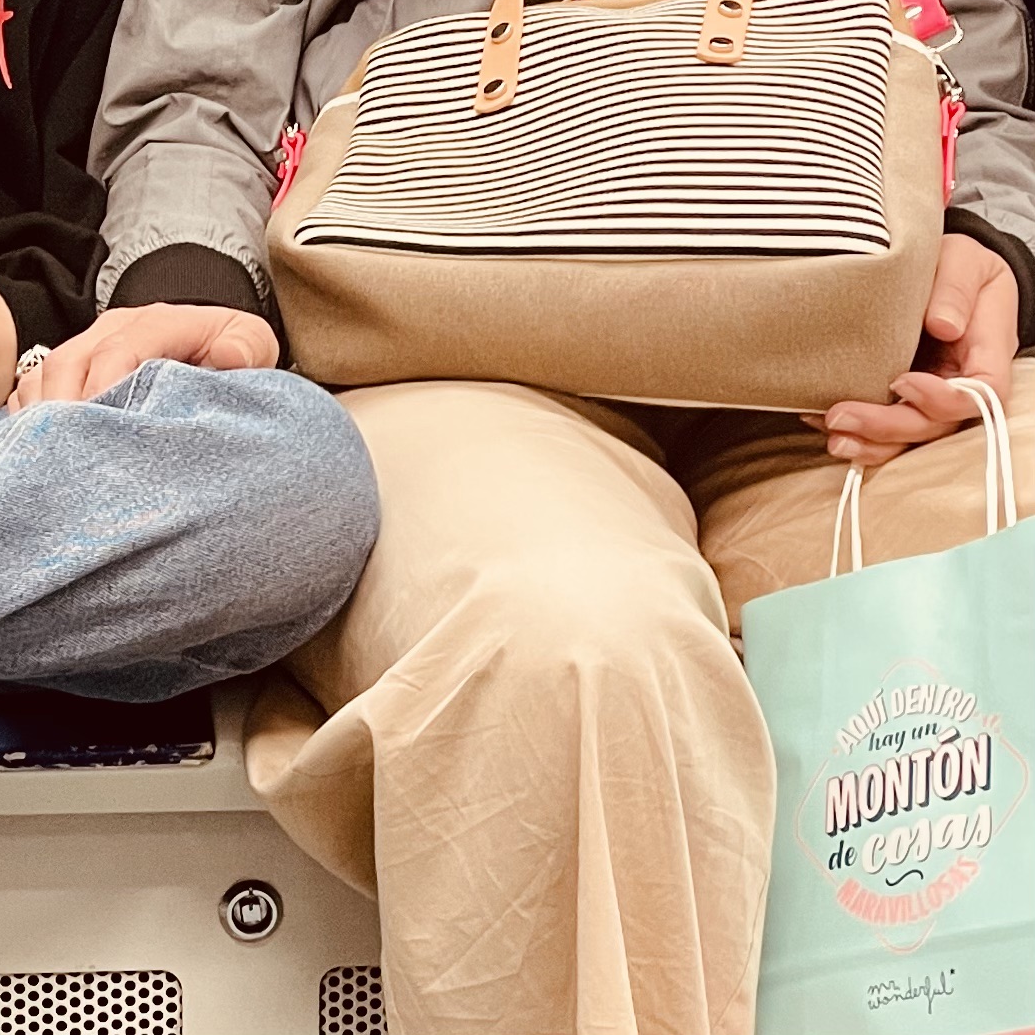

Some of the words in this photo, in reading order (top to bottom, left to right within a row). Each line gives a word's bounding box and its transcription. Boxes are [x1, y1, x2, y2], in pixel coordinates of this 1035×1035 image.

[836, 687, 889, 756] AQUÍ
[890, 684, 978, 723] DENTRO
[868, 731, 907, 753] hay
[911, 722, 939, 740] un
[825, 725, 992, 838] MONTÓN
[828, 839, 858, 871] de
[862, 804, 993, 875] cosas
[836, 854, 981, 926] MARAVILLOSAS
